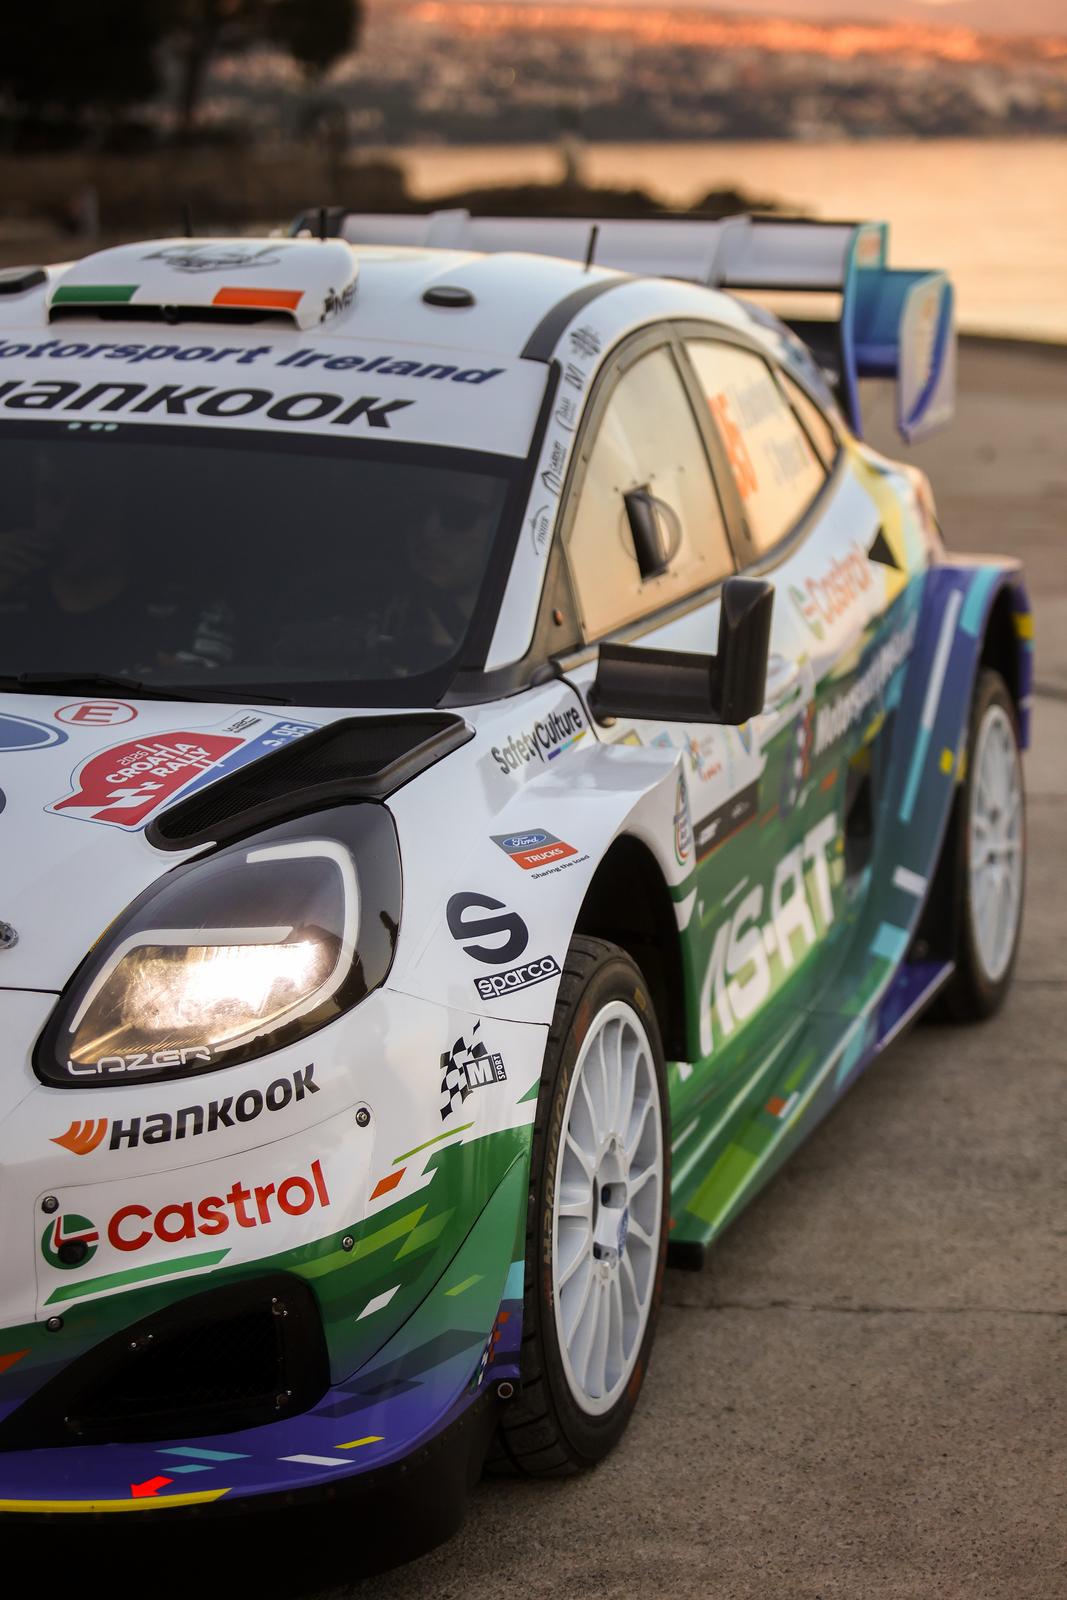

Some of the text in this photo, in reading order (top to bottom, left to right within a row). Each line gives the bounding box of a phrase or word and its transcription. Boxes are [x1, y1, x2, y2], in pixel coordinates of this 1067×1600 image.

[0, 338, 507, 385] otorsport Ireland
[491, 705, 583, 775] SafetyCulture
[105, 742, 198, 785] CROATIA
[116, 750, 150, 766] 2026
[149, 748, 213, 778] RALLY
[511, 835, 539, 847] Ford
[524, 848, 564, 864] TRUCKS
[531, 854, 590, 880] Sharing the load
[477, 957, 555, 996] sparco
[67, 1045, 211, 1076] LAZER
[465, 1058, 495, 1087] M
[493, 1054, 506, 1080] SPORT
[107, 1159, 331, 1252] Castrol
